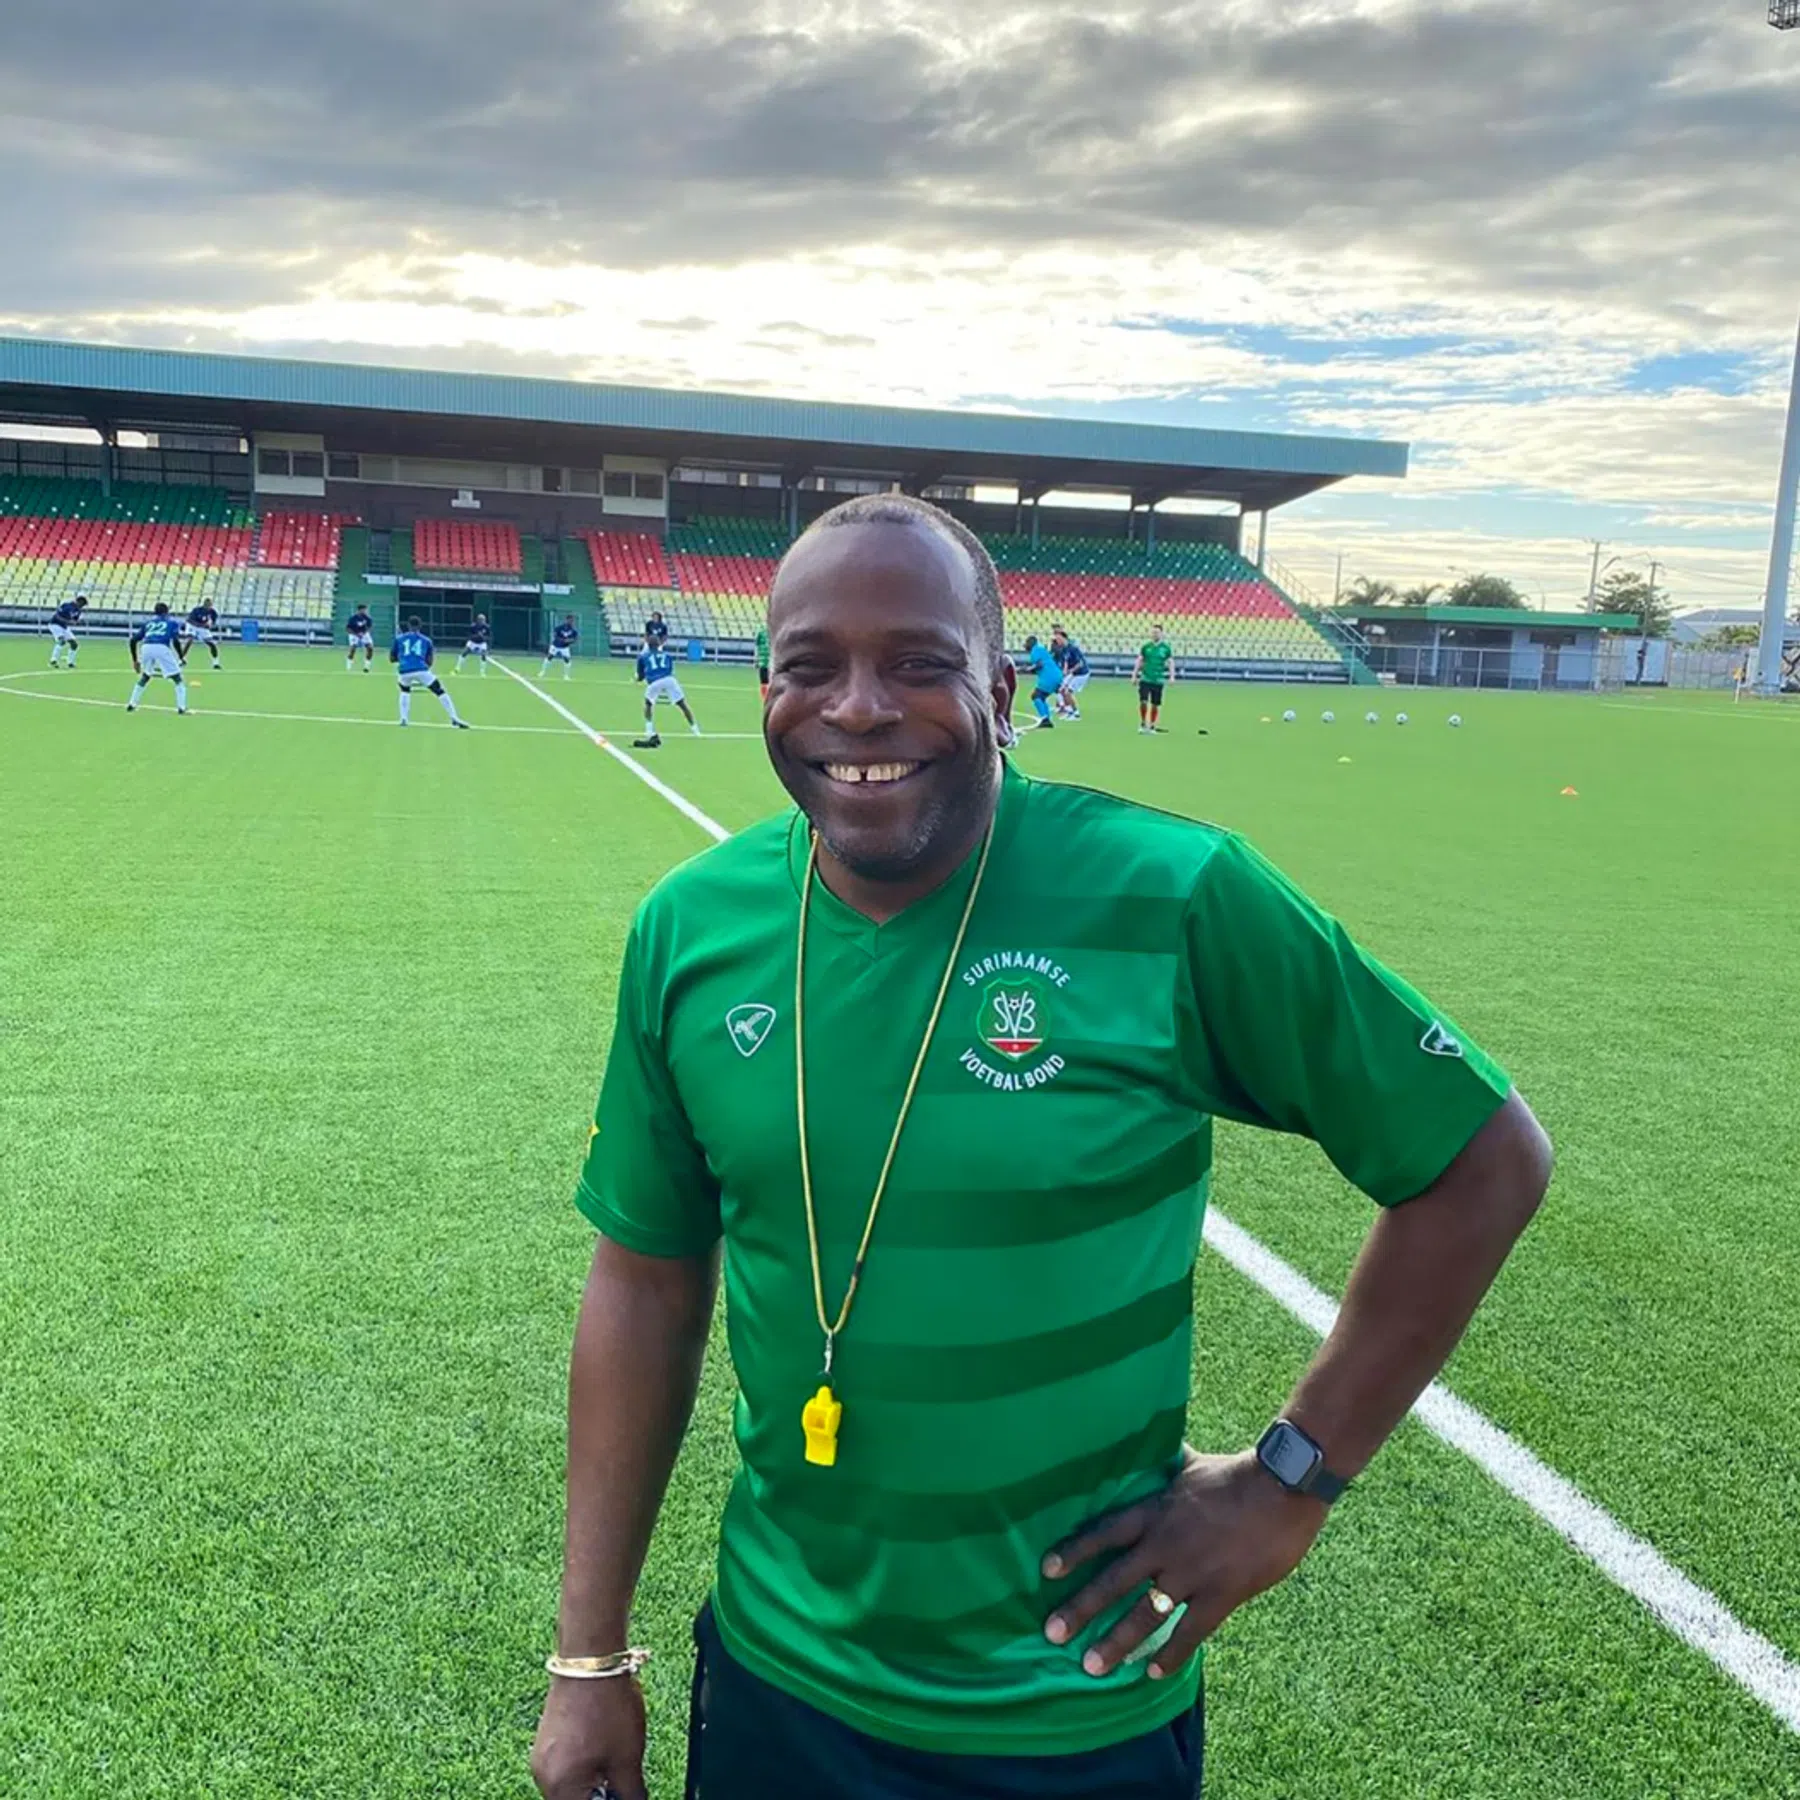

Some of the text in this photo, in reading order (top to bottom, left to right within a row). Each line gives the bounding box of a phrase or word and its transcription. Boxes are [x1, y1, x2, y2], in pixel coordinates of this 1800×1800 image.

[145, 621, 168, 637] 22
[402, 638, 422, 656] 14
[649, 653, 667, 669] 17
[962, 951, 1071, 988] SURINAAMSE
[993, 991, 1036, 1039] SVB
[959, 1047, 1066, 1091] VOETBAL BOND
